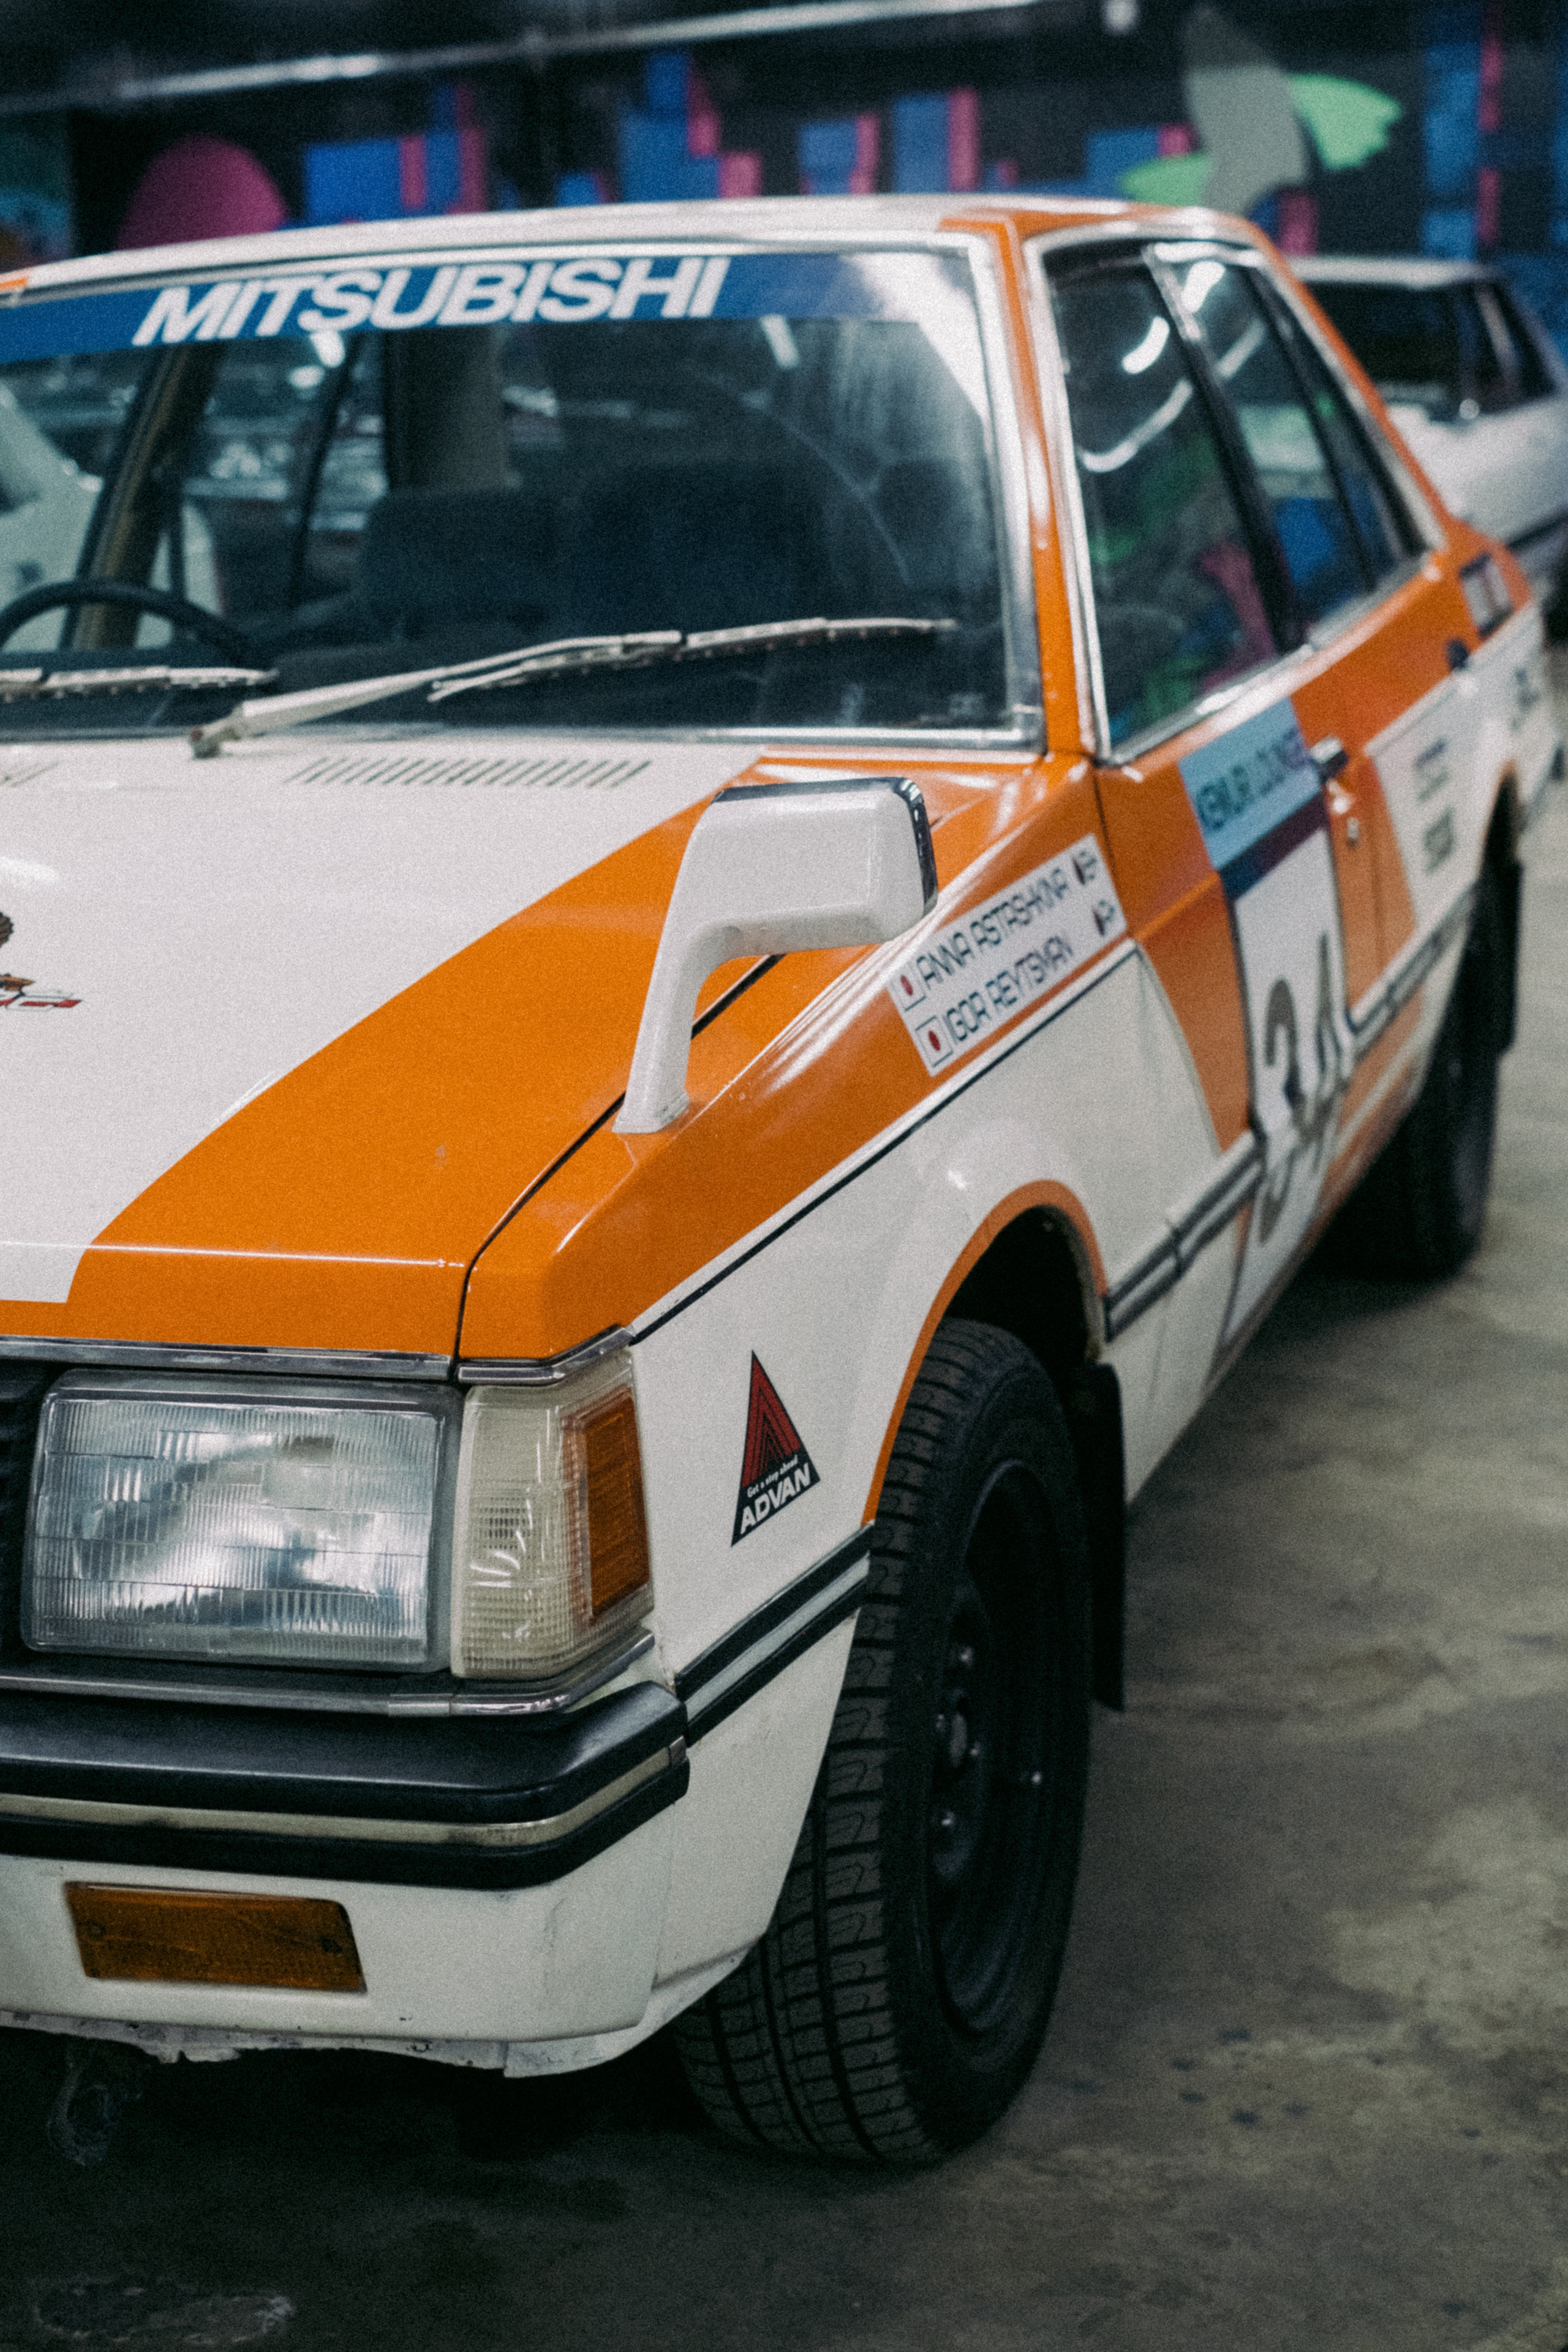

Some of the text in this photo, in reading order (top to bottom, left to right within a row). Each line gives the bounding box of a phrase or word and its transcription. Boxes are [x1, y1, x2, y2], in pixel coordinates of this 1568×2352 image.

[132, 256, 733, 347] MITSUBISHI
[916, 931, 976, 990] ANNA
[941, 990, 993, 1044] IGOR
[740, 1461, 811, 1534] ADVAN
